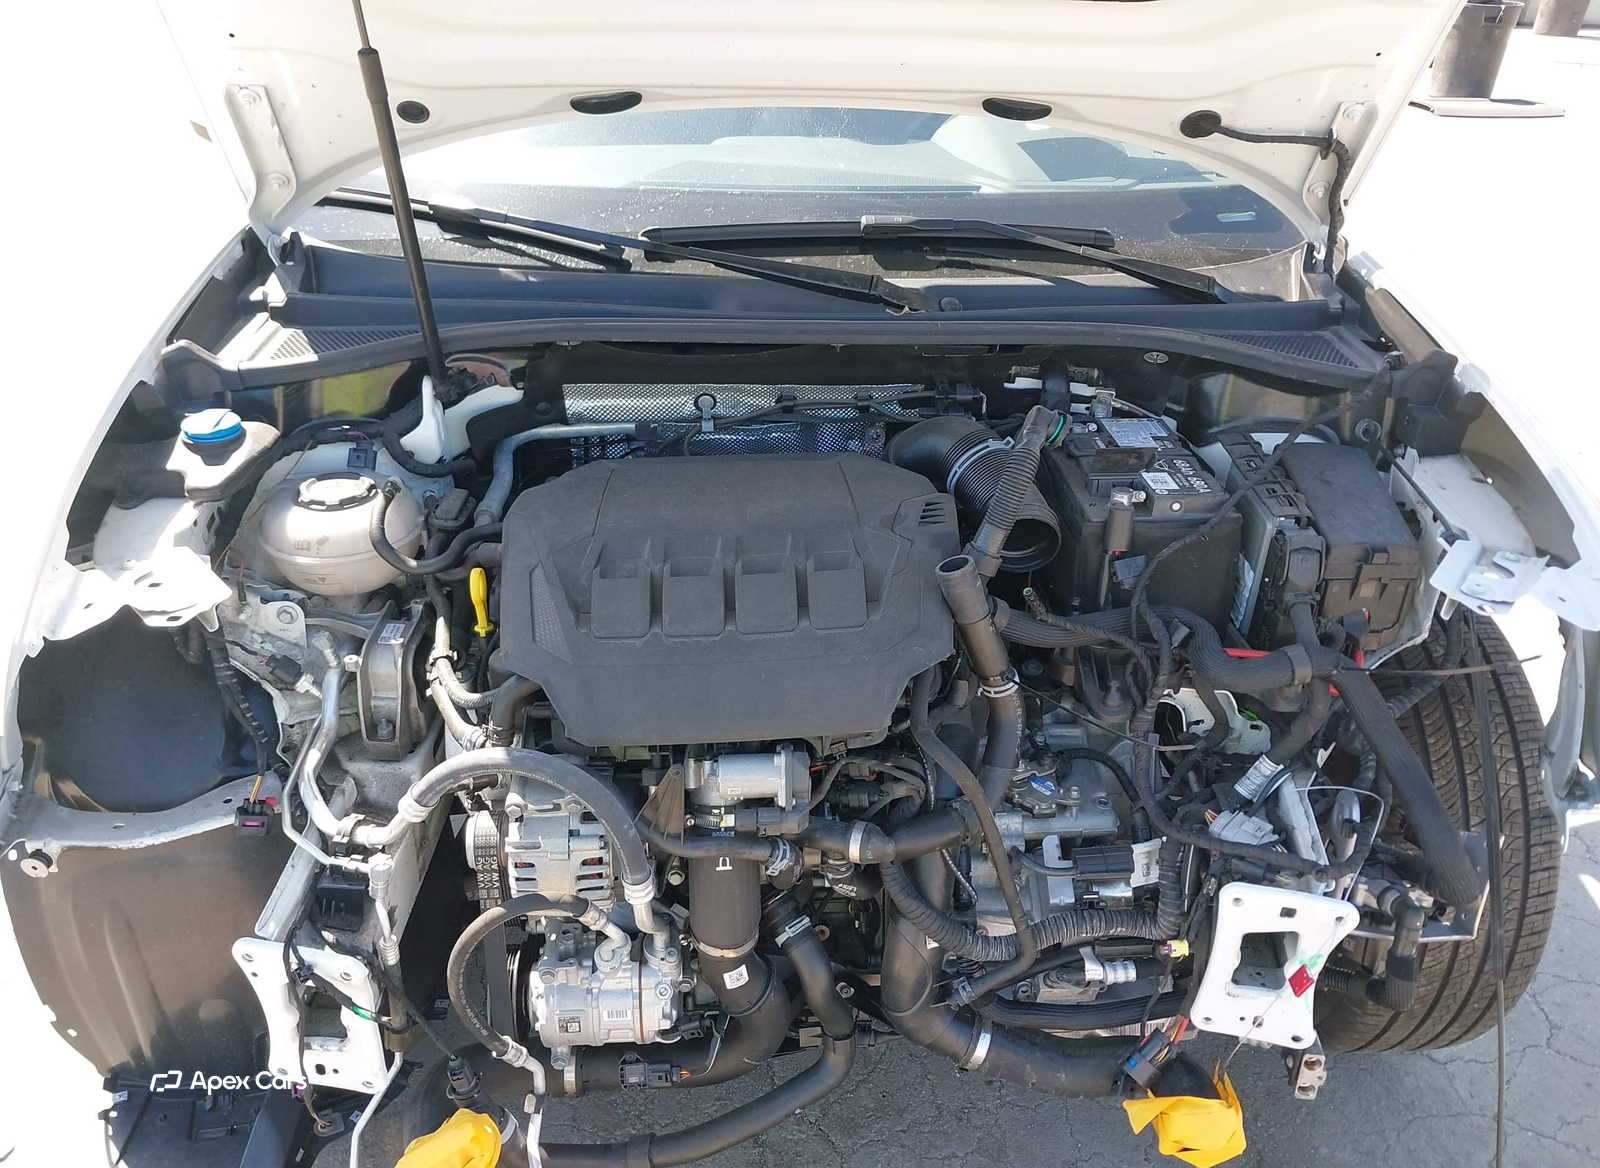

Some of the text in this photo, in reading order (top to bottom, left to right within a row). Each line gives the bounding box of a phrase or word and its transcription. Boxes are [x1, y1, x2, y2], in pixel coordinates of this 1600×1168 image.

[476, 856, 485, 889] VW AG
[483, 856, 492, 889] VW AG
[490, 856, 500, 888] VW AG
